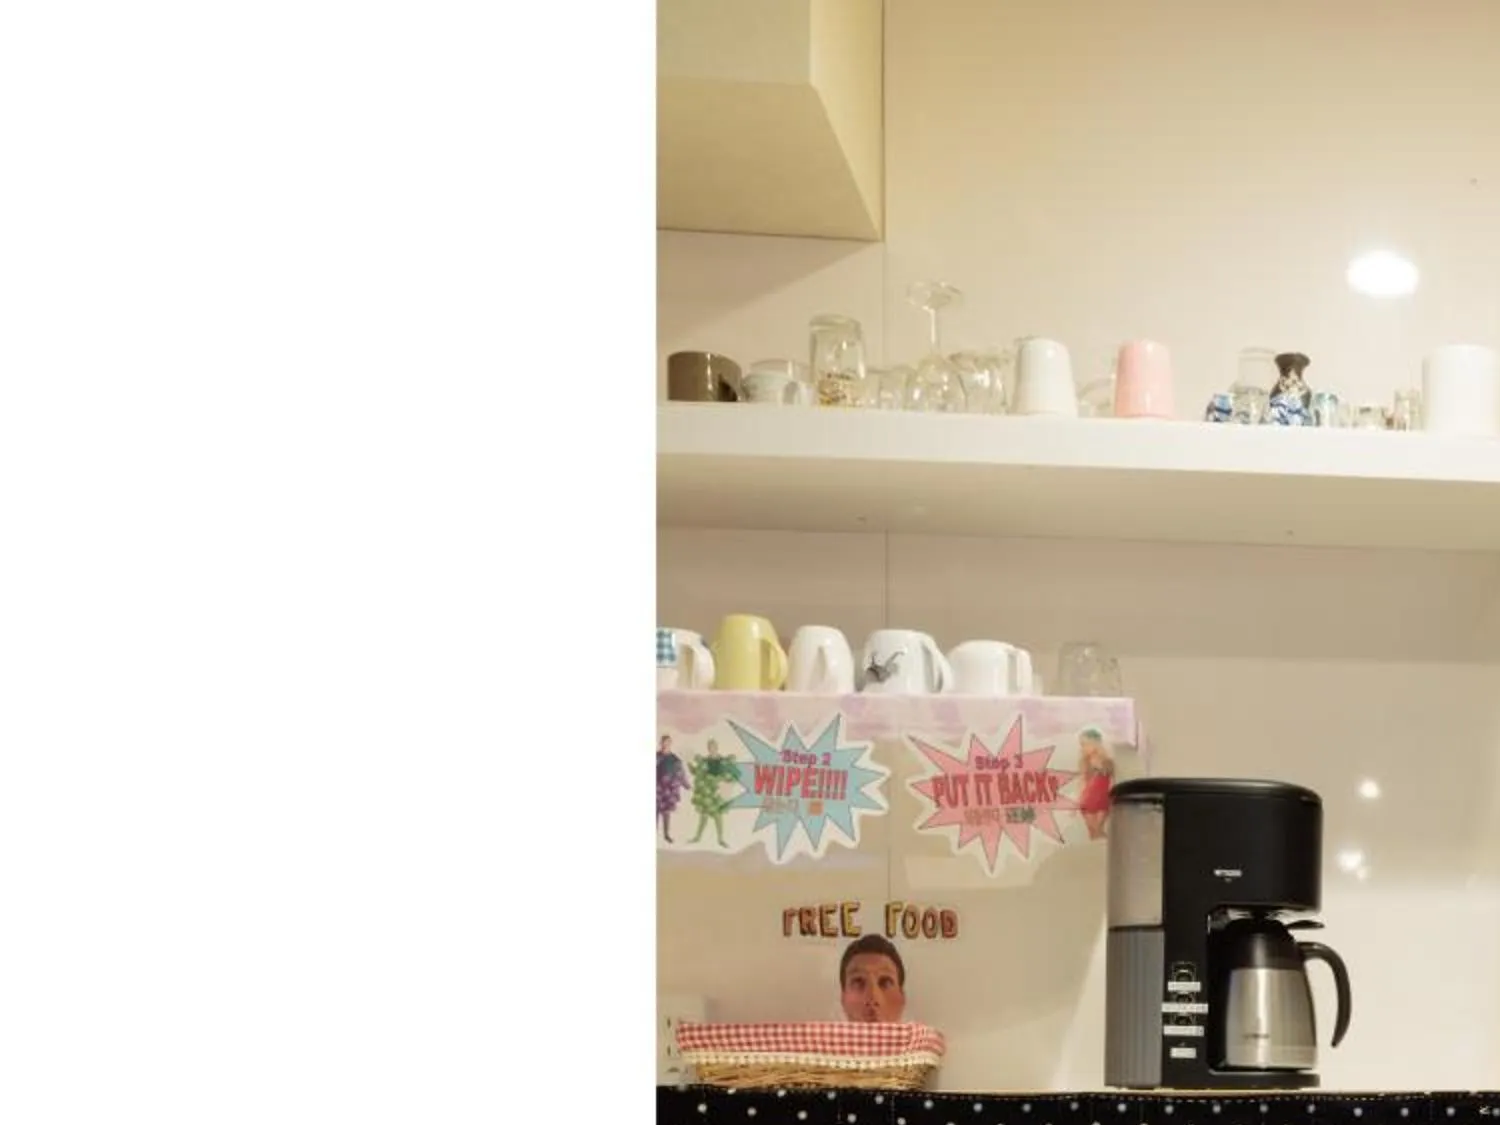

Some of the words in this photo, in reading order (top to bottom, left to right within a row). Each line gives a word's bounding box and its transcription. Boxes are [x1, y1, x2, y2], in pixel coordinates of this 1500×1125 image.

[781, 750, 817, 767] Step
[975, 755, 1010, 773] Step
[932, 773, 969, 808] PUT
[973, 774, 994, 806] IT
[783, 901, 861, 938] FREE
[885, 901, 958, 938] FOOD
